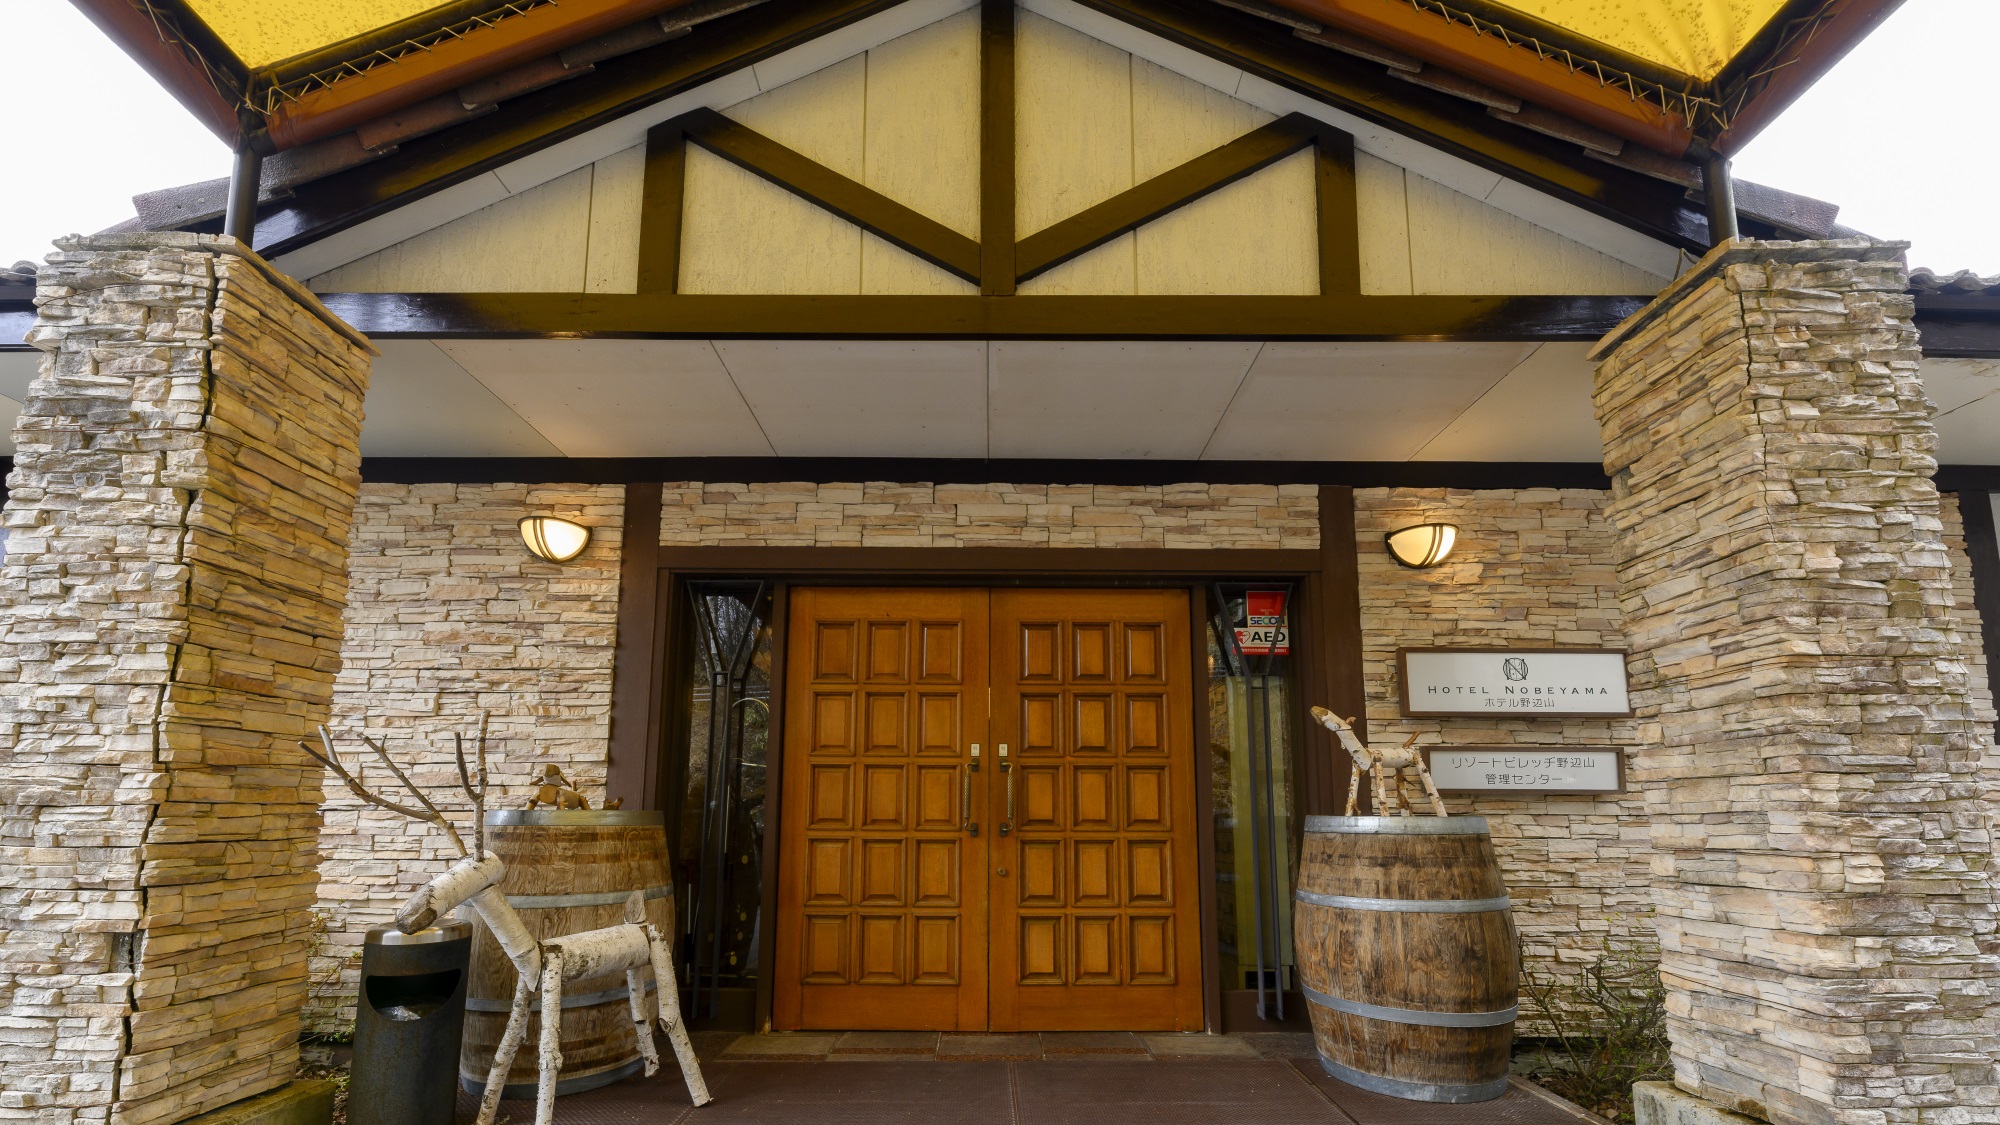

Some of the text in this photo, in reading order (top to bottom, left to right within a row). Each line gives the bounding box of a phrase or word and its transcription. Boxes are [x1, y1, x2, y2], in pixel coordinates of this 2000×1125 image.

[1251, 631, 1285, 642] AED
[1428, 685, 1608, 695] HOTEL NOBEYAMA
[1484, 697, 1555, 708] ホテル野辺山
[1485, 773, 1563, 785] 管理センター
